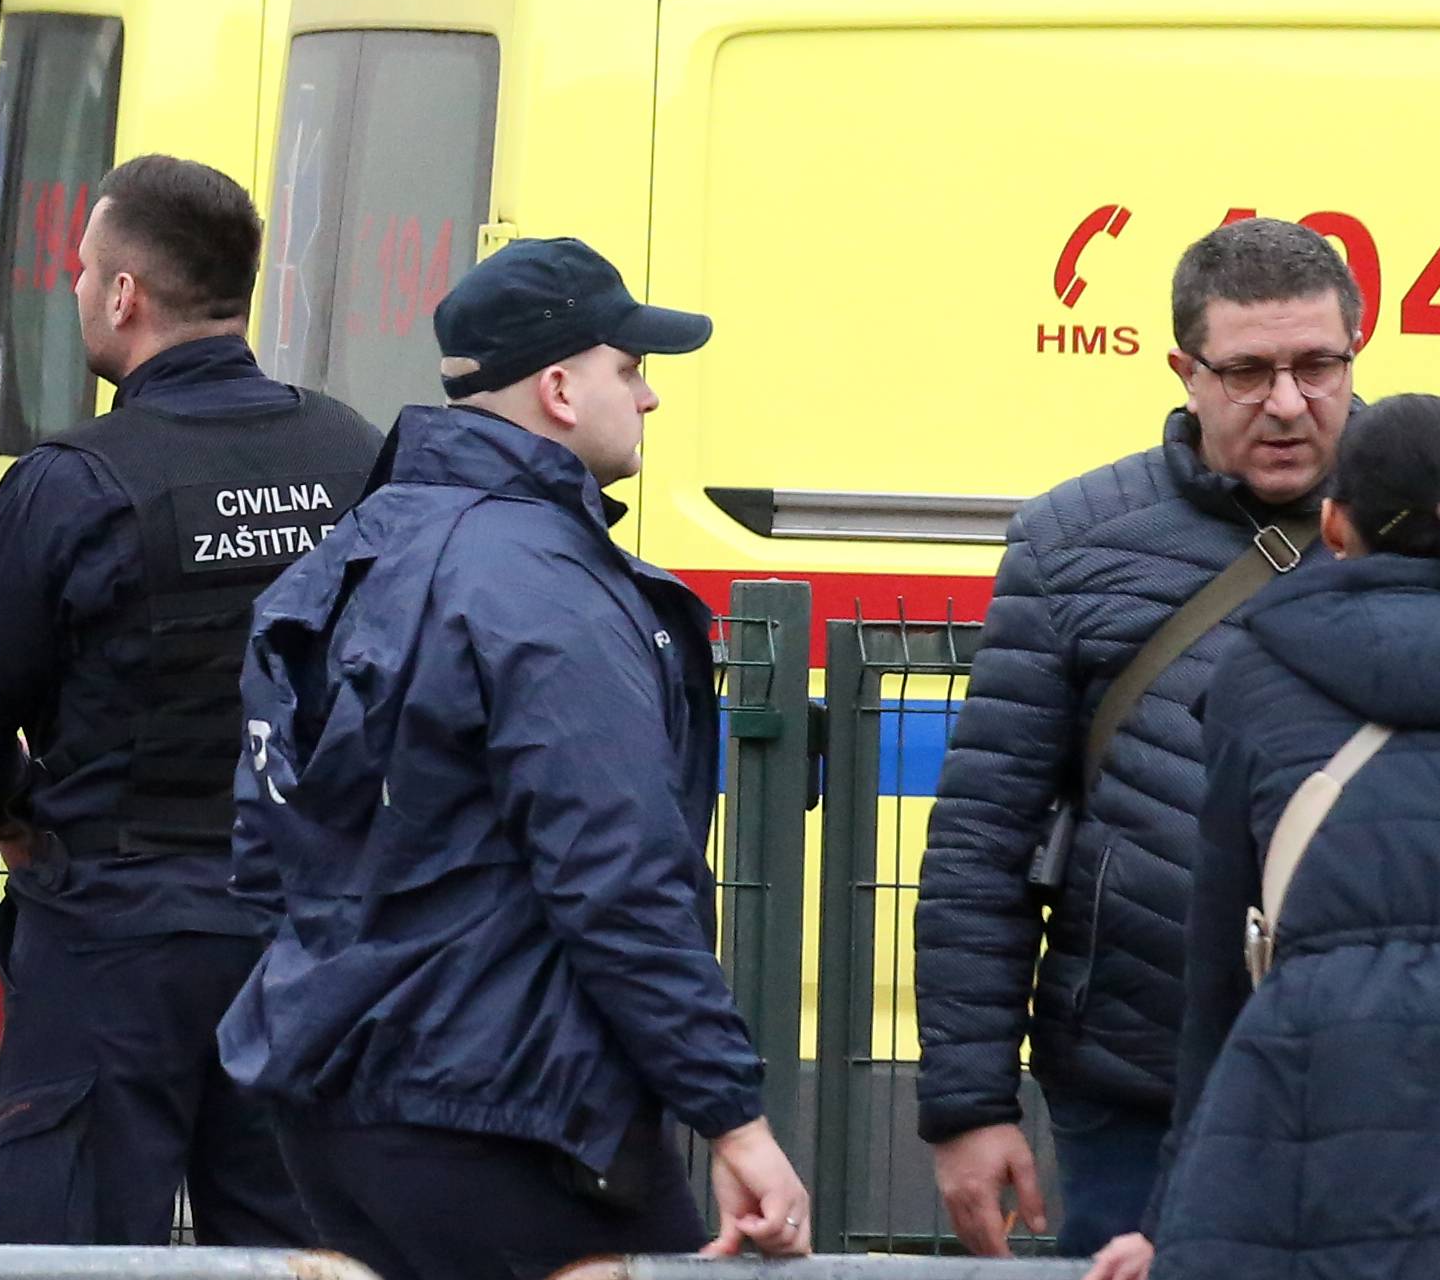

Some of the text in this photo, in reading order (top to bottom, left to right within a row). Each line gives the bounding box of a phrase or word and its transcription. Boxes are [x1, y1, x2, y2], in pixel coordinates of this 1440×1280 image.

[1036, 323, 1140, 356] HMS
[216, 483, 333, 517] CIVILNA
[194, 525, 316, 562] ZAŠTITA
